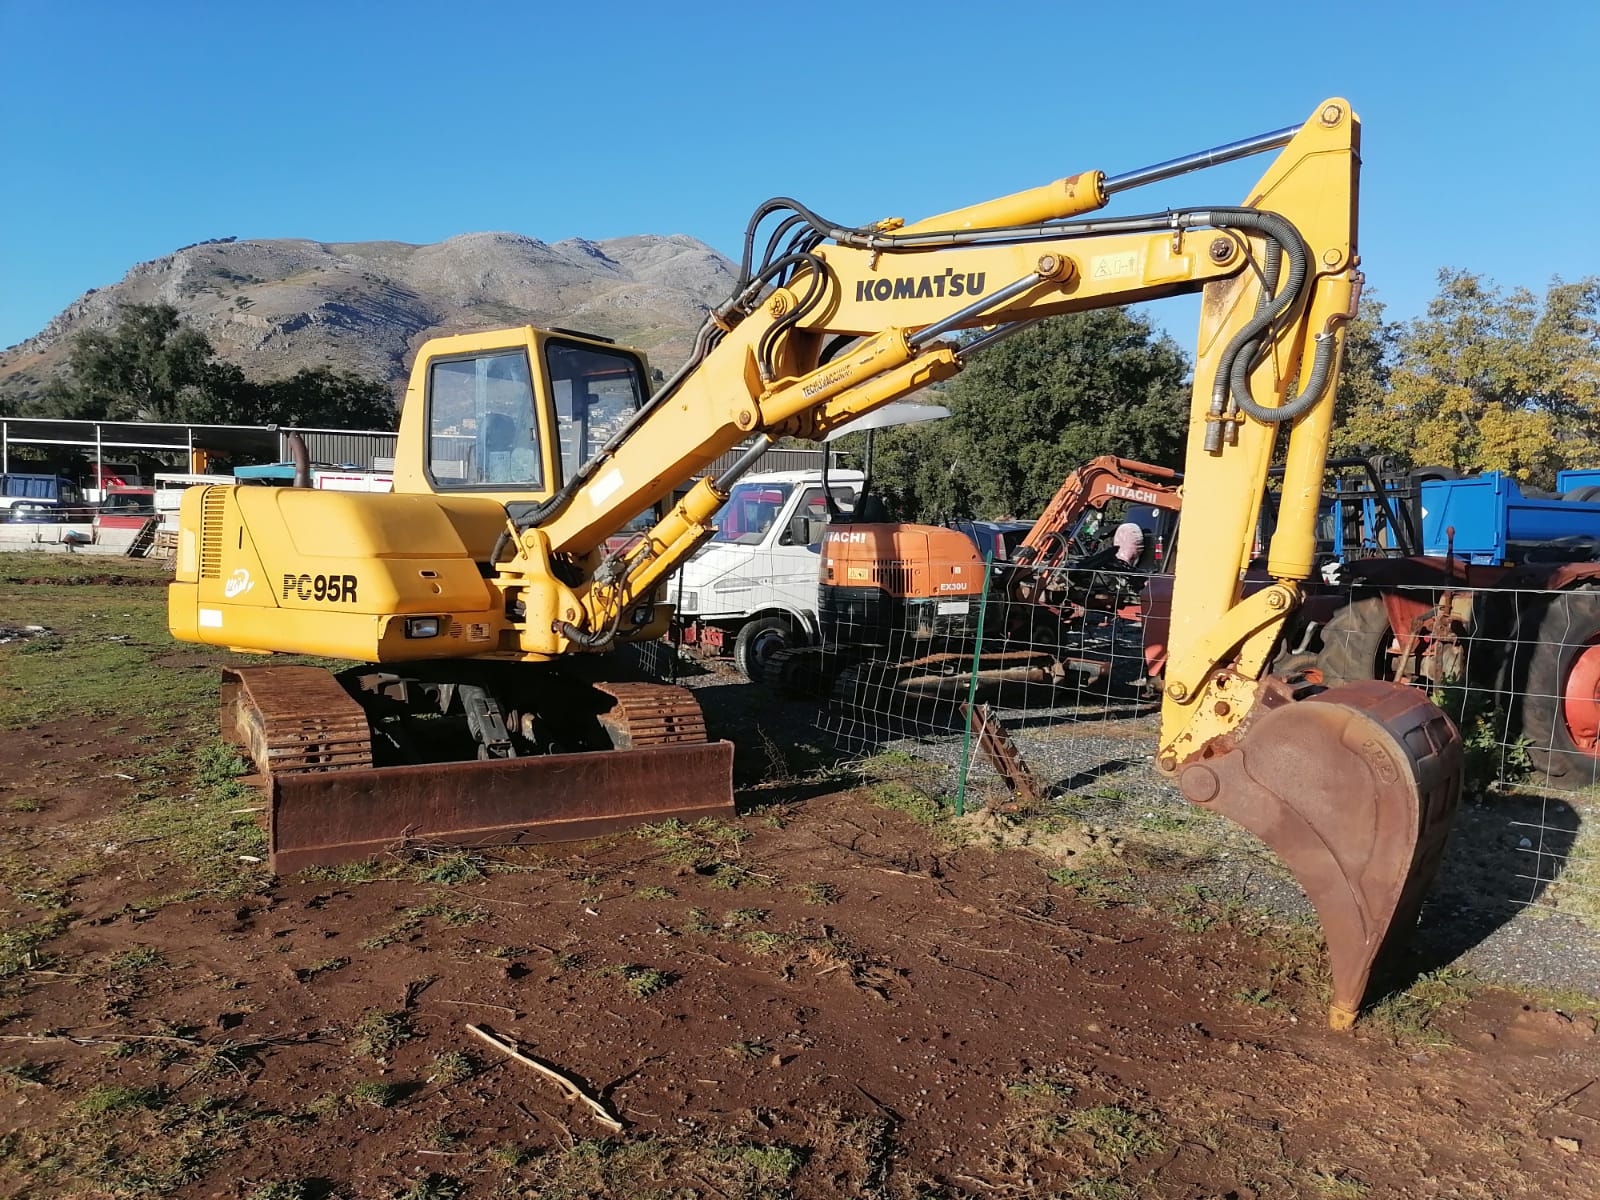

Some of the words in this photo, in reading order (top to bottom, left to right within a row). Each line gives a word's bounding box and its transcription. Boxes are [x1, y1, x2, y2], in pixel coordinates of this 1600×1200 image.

[856, 267, 986, 302] KOMATSU
[1105, 483, 1158, 504] HITACHI
[823, 531, 866, 544] TACHI
[282, 573, 358, 603] PC95R
